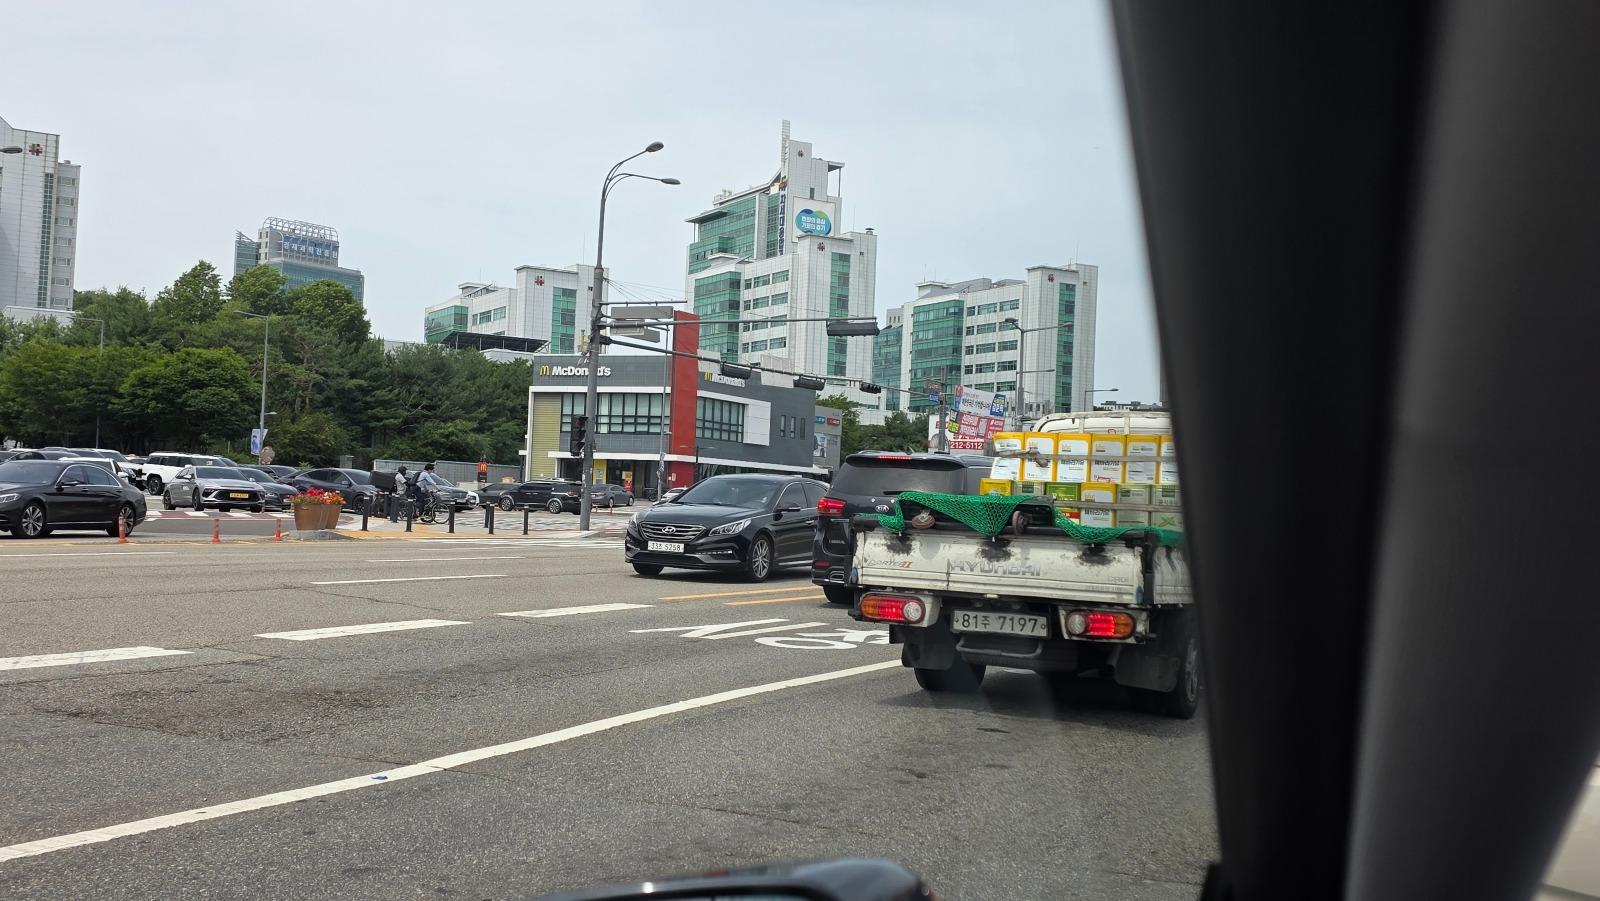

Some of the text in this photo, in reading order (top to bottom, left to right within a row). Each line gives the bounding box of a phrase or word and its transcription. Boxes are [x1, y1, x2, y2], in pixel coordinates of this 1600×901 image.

[801, 222, 815, 230] 기회의
[551, 365, 612, 377] McDond's
[950, 441, 983, 450] 212-5112
[949, 559, 1040, 576] HYUNDAI
[962, 614, 1038, 632] 81주 7197
